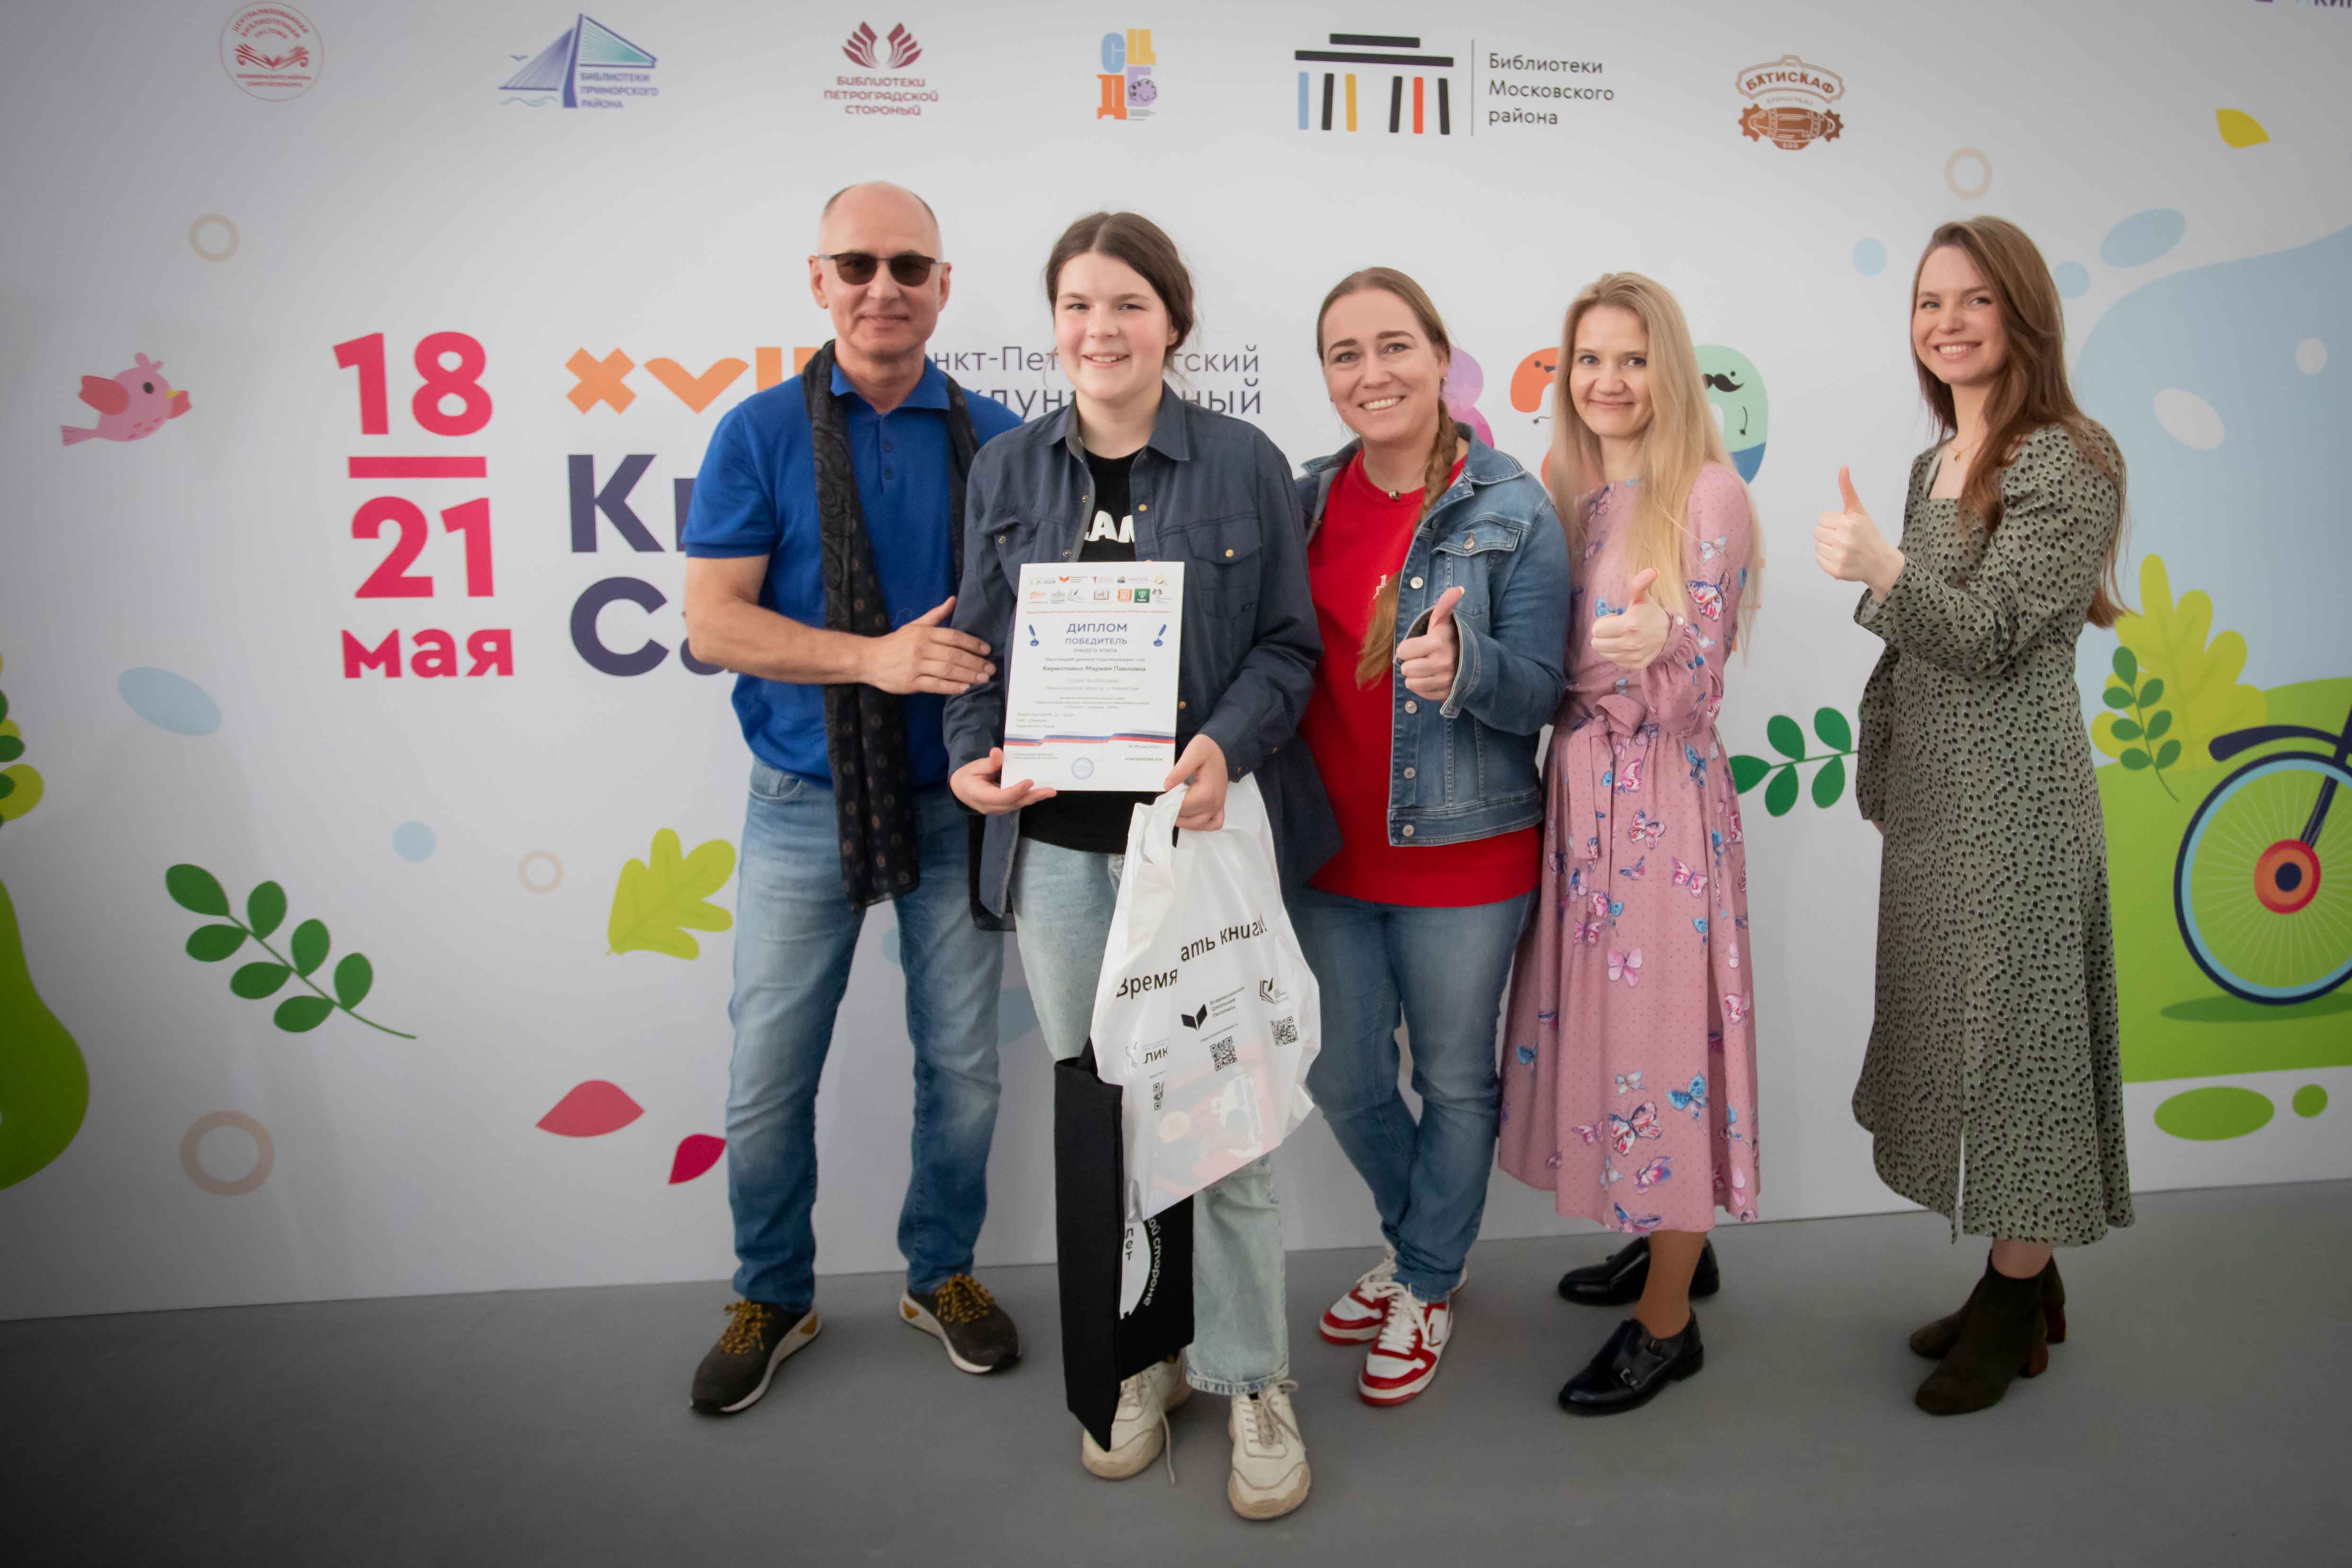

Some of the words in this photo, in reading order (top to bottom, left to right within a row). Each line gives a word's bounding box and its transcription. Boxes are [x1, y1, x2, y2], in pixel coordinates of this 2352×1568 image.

[1490, 53, 1603, 73] Библиотеки
[581, 73, 650, 82] БИБЛИОТЕКИ
[836, 76, 925, 87] БИБЛИОТЕКИ
[1746, 71, 1835, 93] БАТИСКАФ
[581, 86, 659, 96] ПРИМОРСКОГО
[824, 90, 939, 102] ПЕТРОГРАДСКОЙ
[1490, 80, 1614, 100] Московского
[582, 99, 623, 109] РАЙОНА
[1490, 107, 1558, 125] района
[333, 331, 492, 436] 18
[351, 496, 494, 599] 21
[1066, 623, 1127, 634] ДИПЛОМ
[341, 628, 515, 679] мая
[1180, 936, 1216, 962] ать
